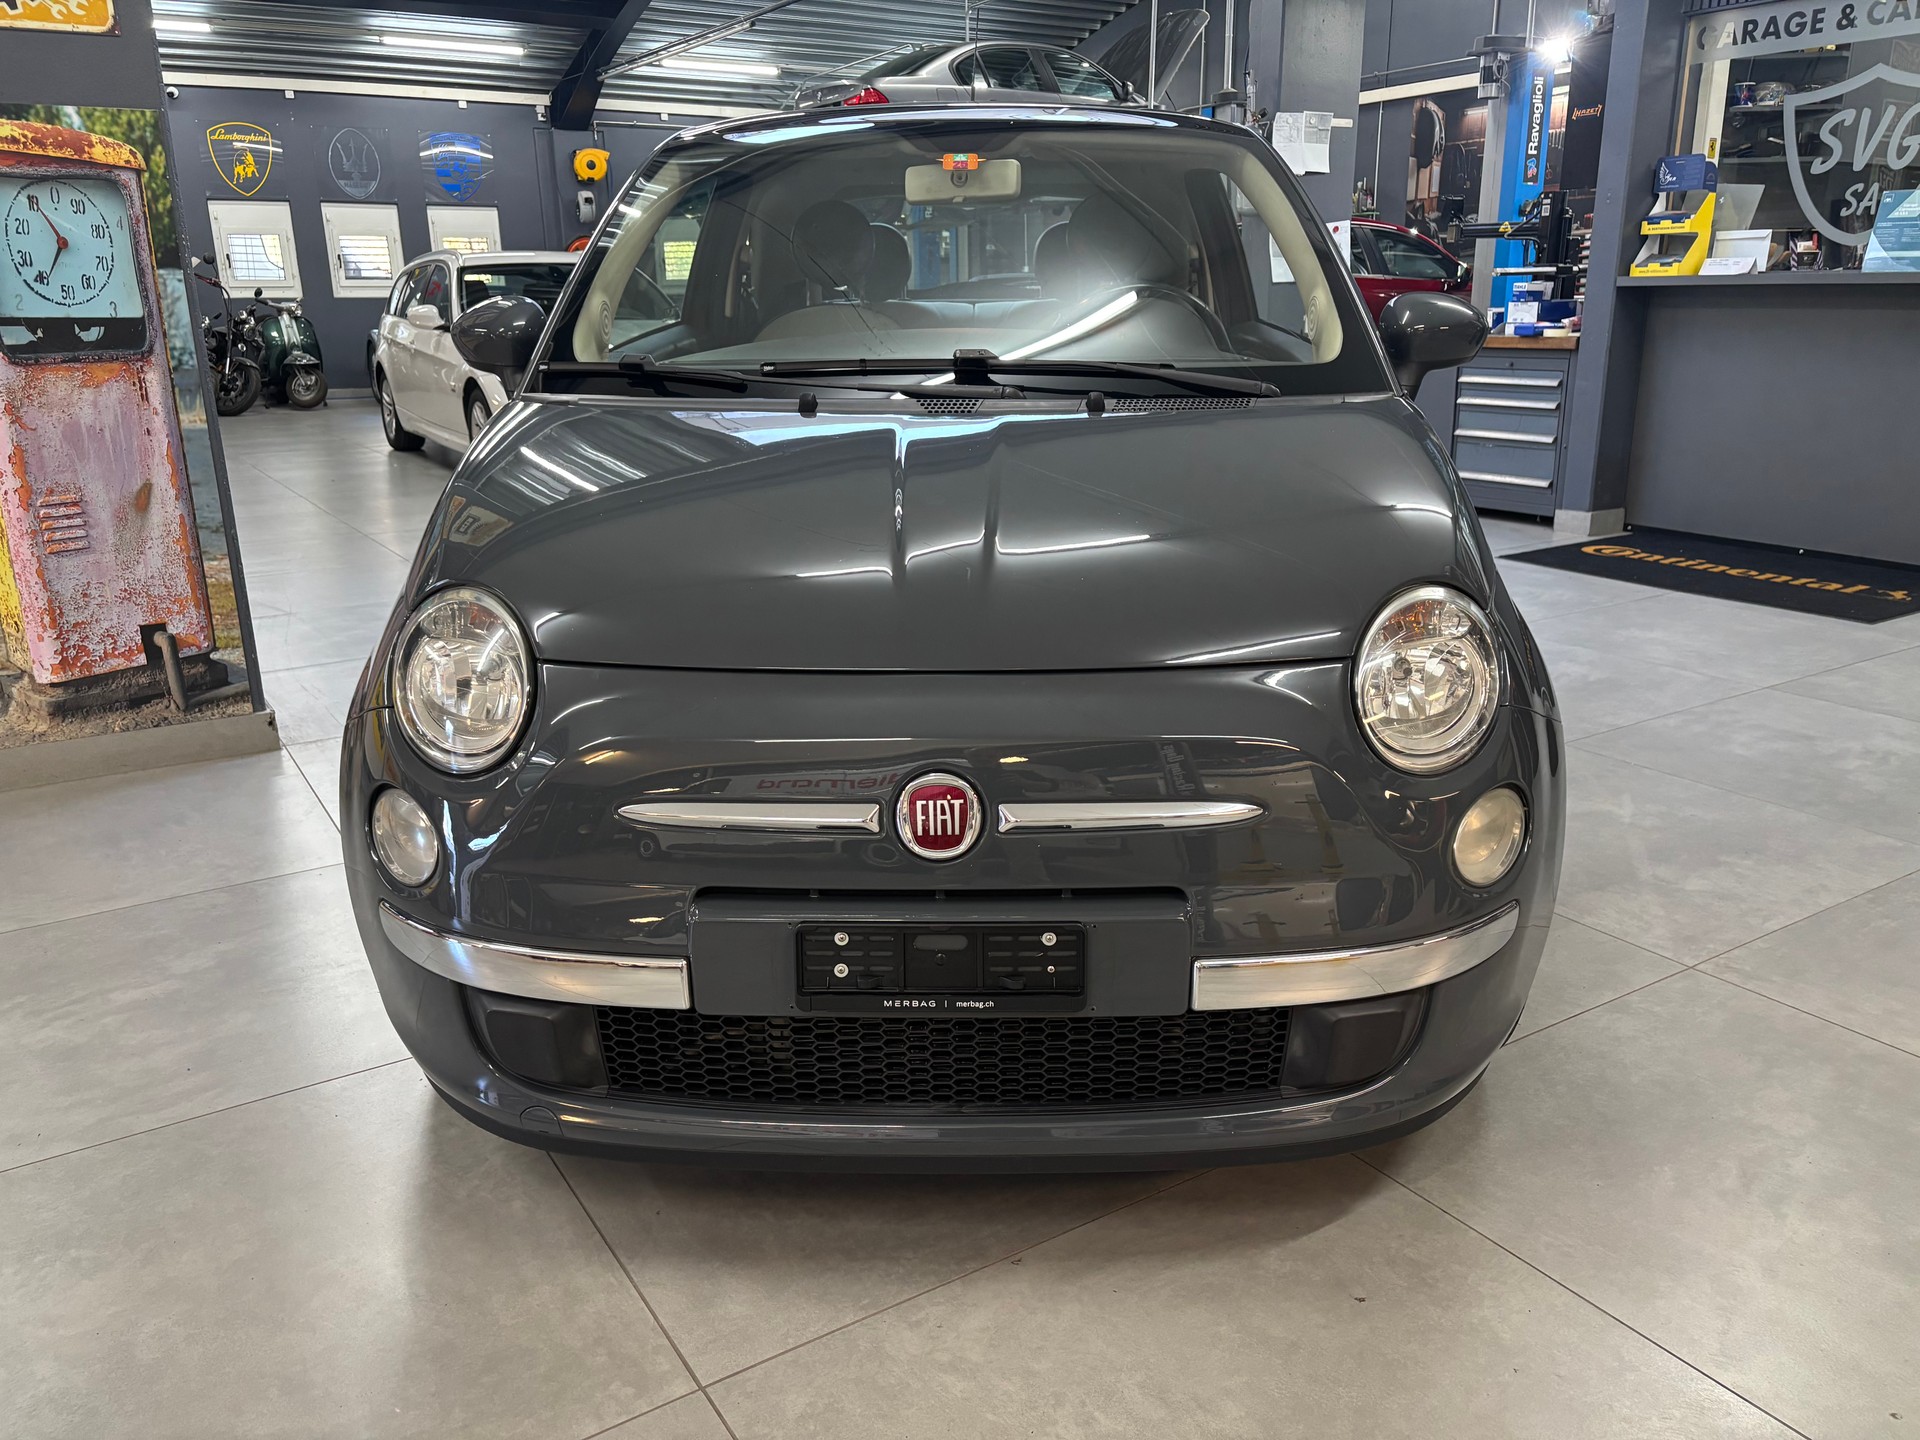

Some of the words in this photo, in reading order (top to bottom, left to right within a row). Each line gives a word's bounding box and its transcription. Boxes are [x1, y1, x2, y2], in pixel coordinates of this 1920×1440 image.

[1836, 3, 1858, 31] &
[1527, 76, 1545, 155] Ravaglioli
[1573, 105, 1602, 119] HAZET
[211, 128, 268, 144] Lamborghini
[1810, 103, 1920, 175] SVG
[70, 198, 86, 215] 90
[15, 218, 30, 235] 20
[91, 223, 106, 239] 80
[17, 250, 33, 267] 30
[95, 255, 109, 272] 70
[81, 273, 96, 290] 60
[60, 284, 76, 301] 50
[1581, 545, 1871, 594] Continental
[915, 799, 964, 836] FIAT
[883, 1000, 936, 1008] MERBAG
[956, 1000, 995, 1009] merbag.ch
